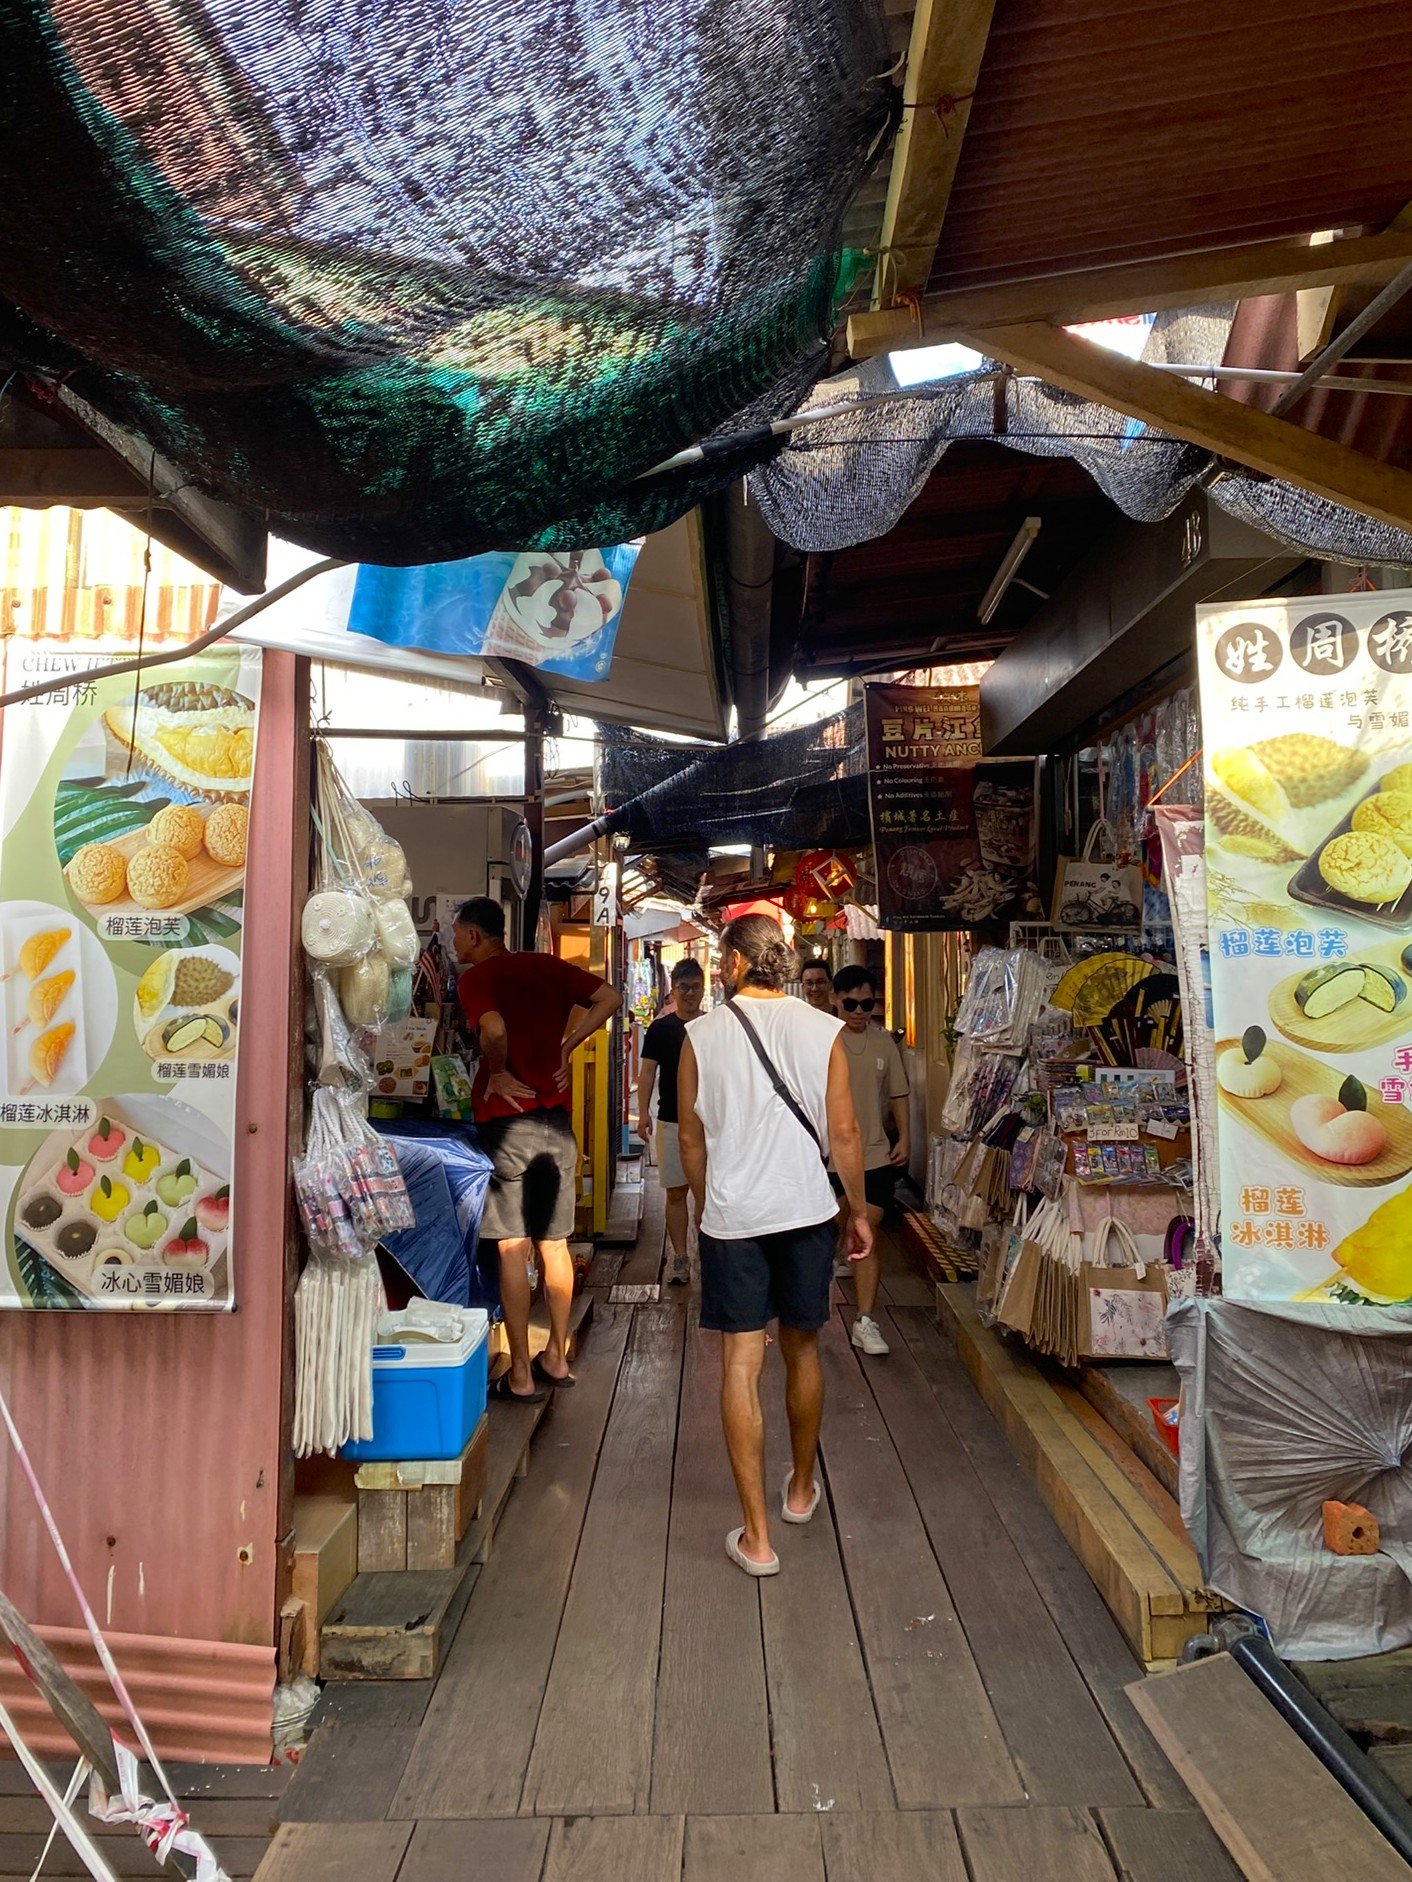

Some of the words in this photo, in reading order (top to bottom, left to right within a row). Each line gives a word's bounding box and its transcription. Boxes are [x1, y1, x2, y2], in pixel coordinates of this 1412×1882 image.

[22, 657, 80, 672] CHEW
[1230, 688, 1380, 712] 纯手工榴莲泡芙
[885, 745, 940, 759] NUTTY
[944, 742, 983, 757] ANC
[1064, 880, 1096, 888] PENANG
[106, 915, 181, 936] 榴莲泡芙
[1220, 929, 1348, 958] 榴莲泡芙
[157, 1062, 230, 1079] 榴莲雪媚娘
[1381, 1078, 1412, 1102] 雪
[0, 1103, 91, 1123] 榴莲冰淇淋
[1241, 1187, 1305, 1216] 榴莲
[1230, 1223, 1330, 1250] 冰淇淋
[101, 1272, 206, 1294] 冰心雪媚娘
